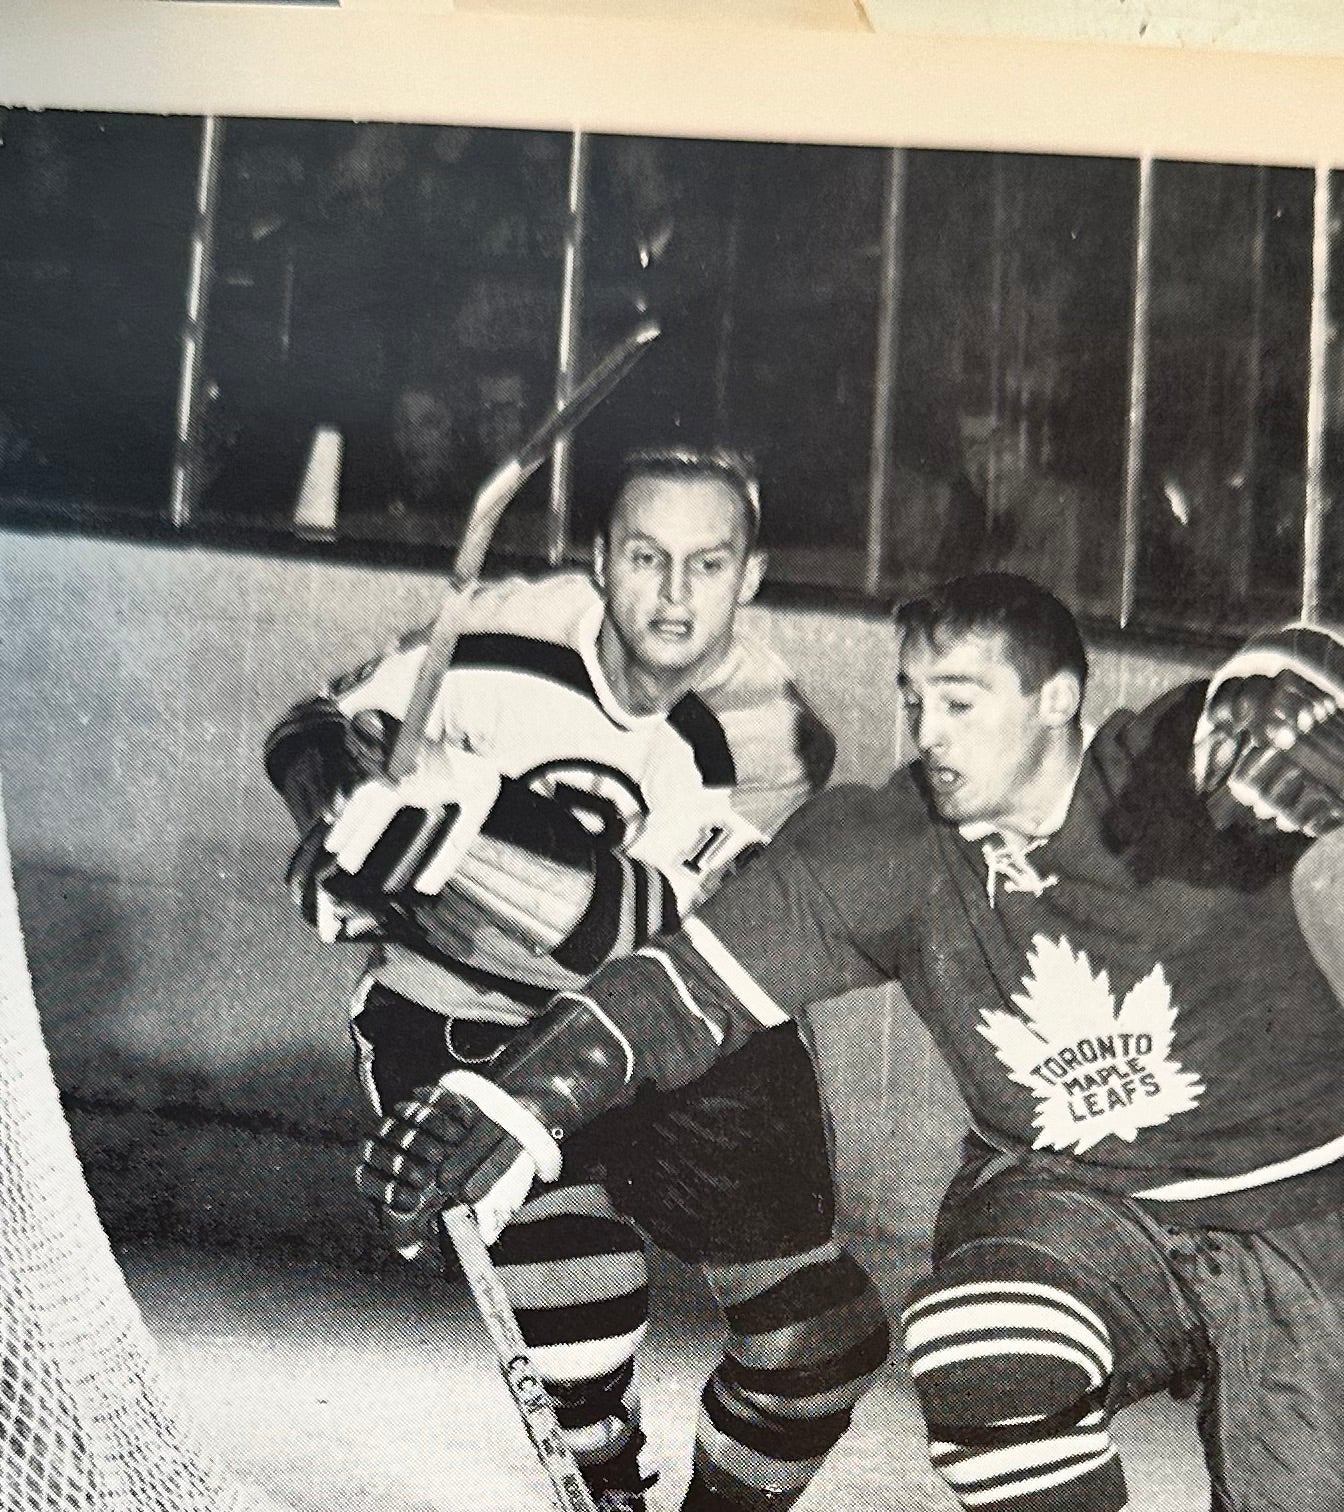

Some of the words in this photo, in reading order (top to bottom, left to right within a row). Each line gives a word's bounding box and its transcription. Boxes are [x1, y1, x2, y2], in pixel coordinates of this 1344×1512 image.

[1029, 1033, 1153, 1086] TORONTO
[1061, 1057, 1146, 1097] MAPLE
[1067, 1072, 1162, 1123] LEAFS
